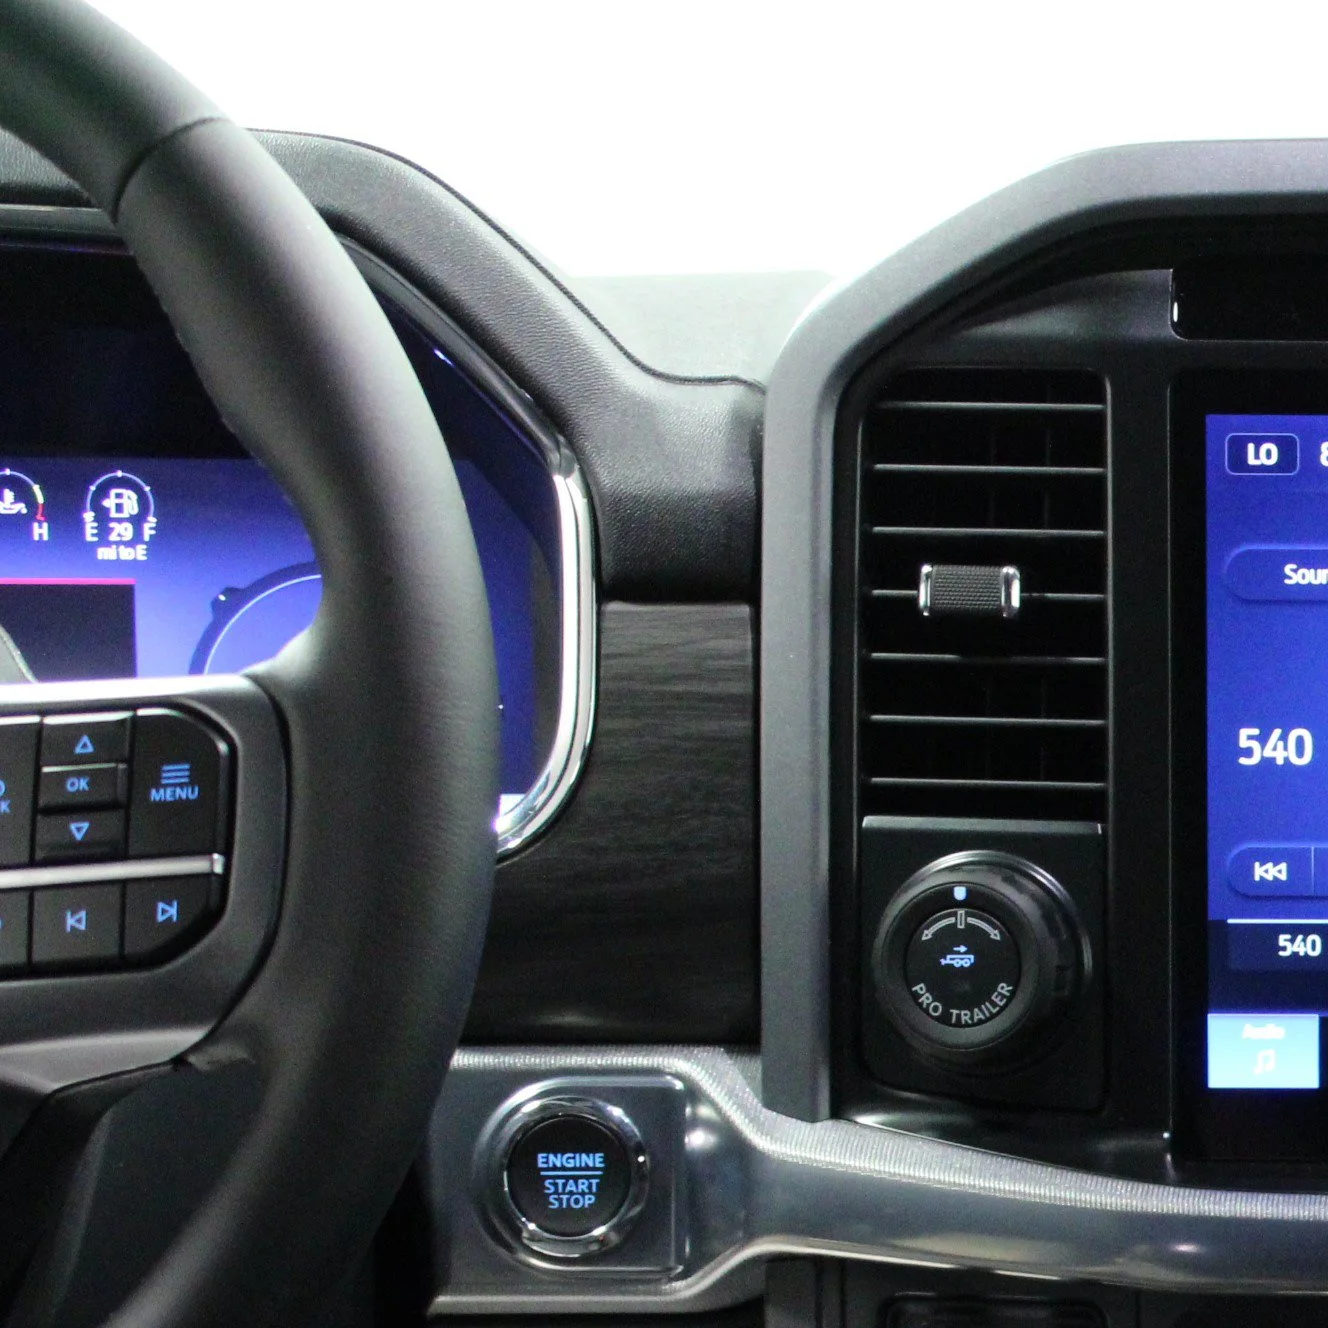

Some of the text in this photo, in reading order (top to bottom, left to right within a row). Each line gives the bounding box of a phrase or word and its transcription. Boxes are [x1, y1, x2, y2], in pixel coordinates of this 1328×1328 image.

[1247, 442, 1279, 466] LO
[32, 521, 50, 542] H
[108, 521, 134, 542] 29
[1238, 727, 1314, 766] 540
[65, 777, 89, 793] OK
[150, 785, 199, 802] MENU
[1278, 933, 1323, 957] 540
[911, 982, 1014, 1024] PRO TRAILER
[537, 1152, 605, 1169] ENGINE
[544, 1178, 600, 1194] START
[548, 1194, 596, 1209] STOP
